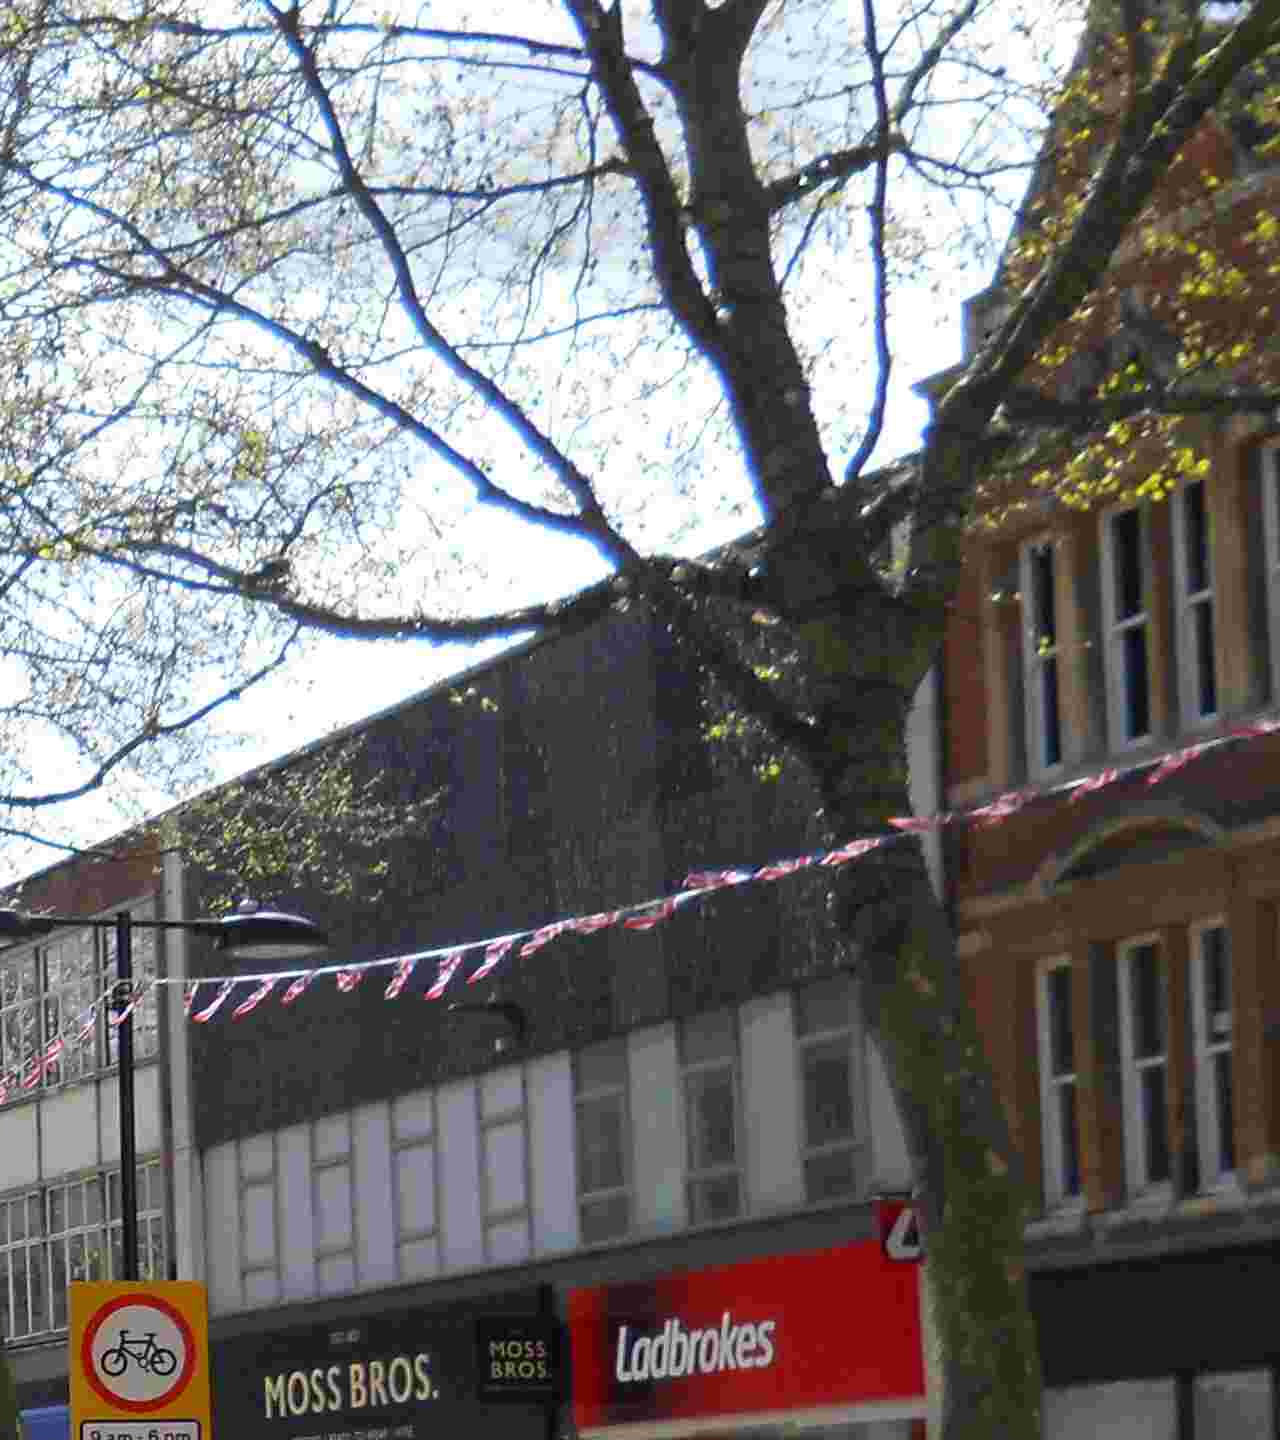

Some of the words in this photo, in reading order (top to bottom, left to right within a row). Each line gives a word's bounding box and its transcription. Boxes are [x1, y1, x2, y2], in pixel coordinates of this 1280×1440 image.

[489, 1340, 545, 1361] MOSS
[616, 1310, 776, 1383] Ladbrokes
[263, 1365, 342, 1419] MOSS
[349, 1353, 440, 1409] BROS.
